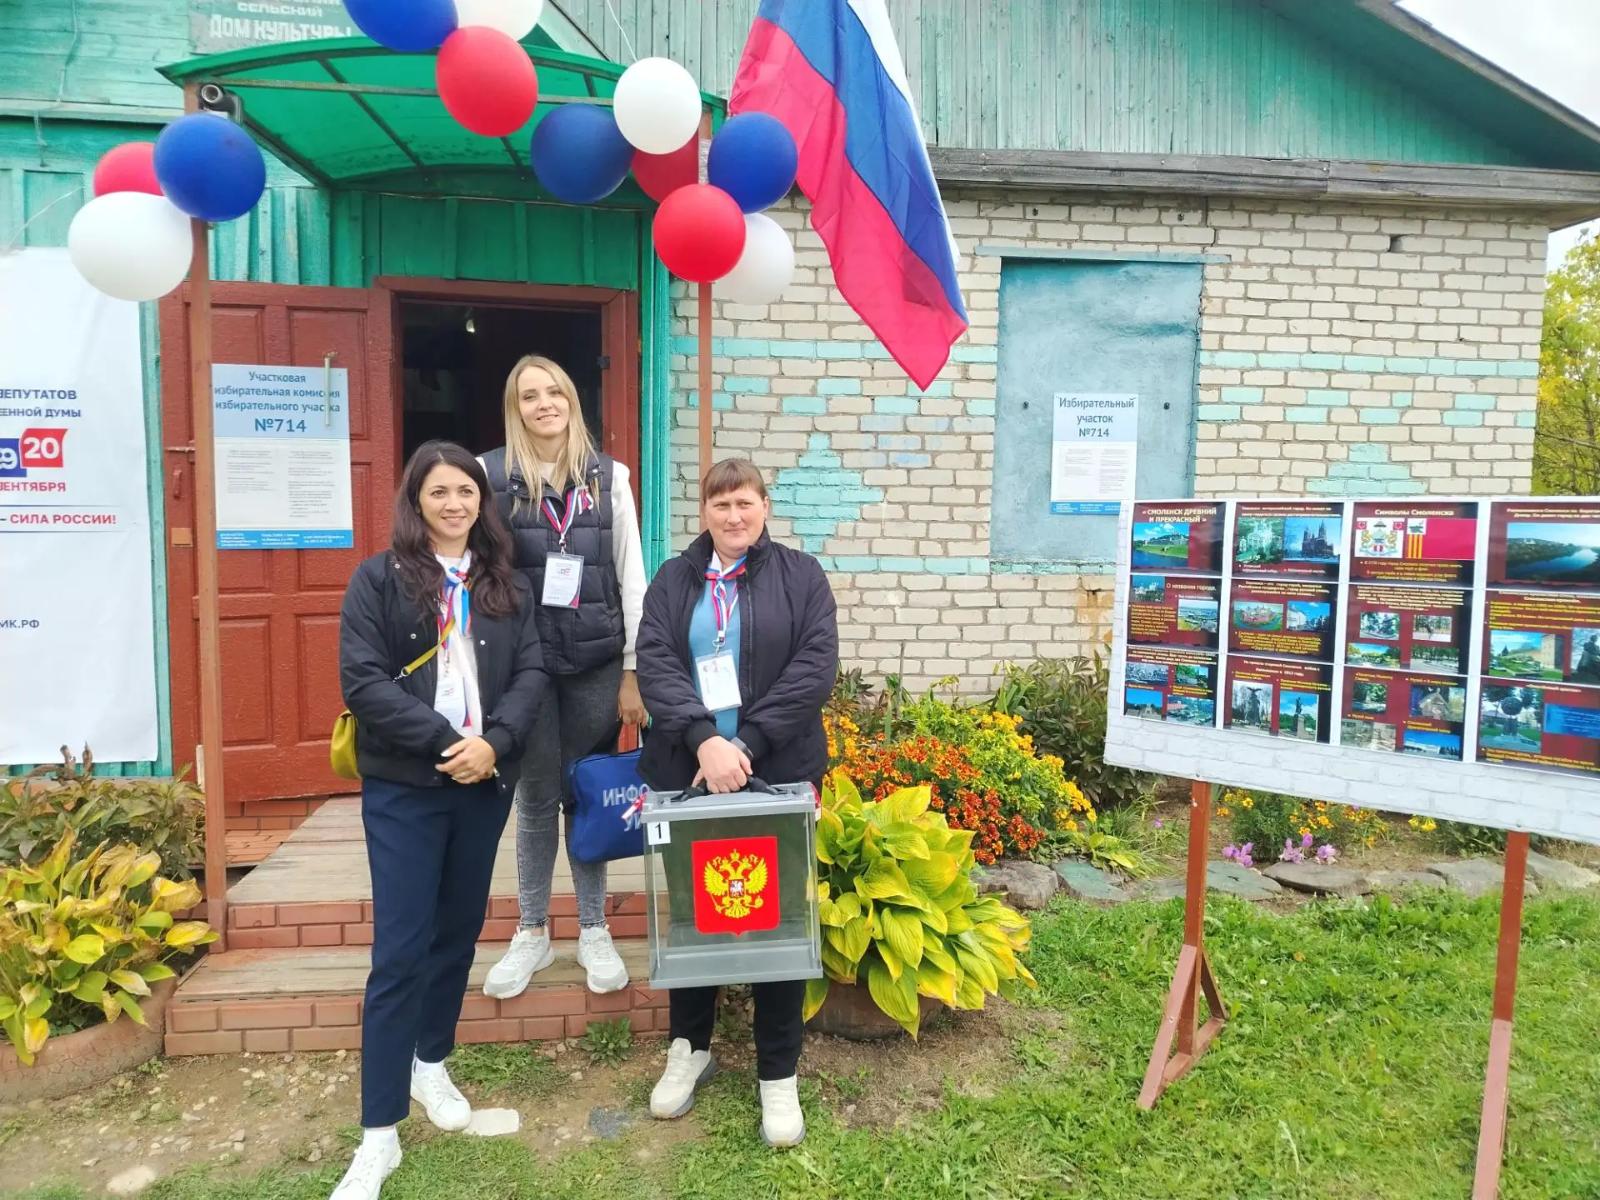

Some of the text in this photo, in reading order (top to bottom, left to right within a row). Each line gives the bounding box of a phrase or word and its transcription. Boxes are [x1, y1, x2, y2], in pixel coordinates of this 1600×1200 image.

[236, 2, 323, 17] СЕЛЬСКИЙ
[209, 14, 352, 42] ДОМ КУЛЬТУРЫ
[248, 371, 306, 383] Участковая
[0, 389, 78, 401] ЕПУТАТОВ
[214, 385, 340, 400] избирательная комисия
[215, 400, 340, 413] избирательного учаска
[1058, 396, 1135, 410] Избирательный
[44, 408, 82, 419] ДУМЫ
[254, 418, 307, 433] №714
[1076, 415, 1114, 426] участок
[1078, 427, 1110, 438] №714
[24, 437, 60, 459] 20
[0, 481, 67, 493] ЕНТЯБРЯ
[1147, 508, 1183, 516] СМОЛЕНСК
[1183, 507, 1217, 516] ДРЕВНИЙ
[10, 514, 49, 525] СИЛА
[53, 514, 117, 525] РОССИИ!
[655, 822, 662, 840] 1
